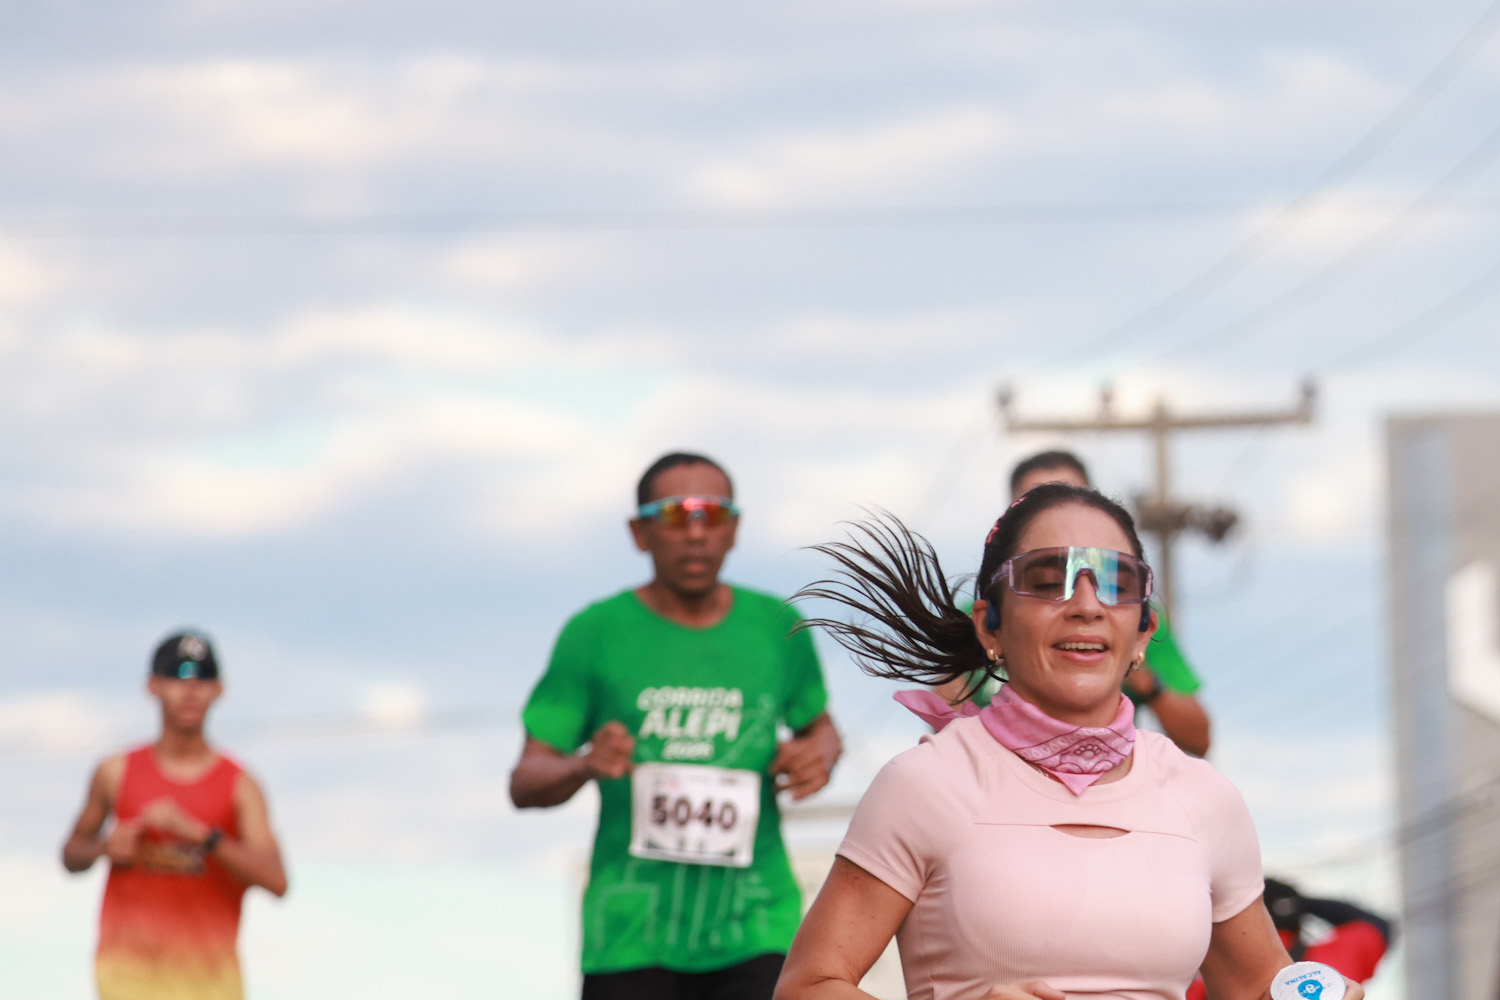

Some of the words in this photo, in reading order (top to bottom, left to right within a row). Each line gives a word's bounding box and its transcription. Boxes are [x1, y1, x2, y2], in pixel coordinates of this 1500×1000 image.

[639, 706, 742, 741] ALEPI
[651, 794, 738, 831] 5040
[1285, 970, 1321, 985] ALCALINA
